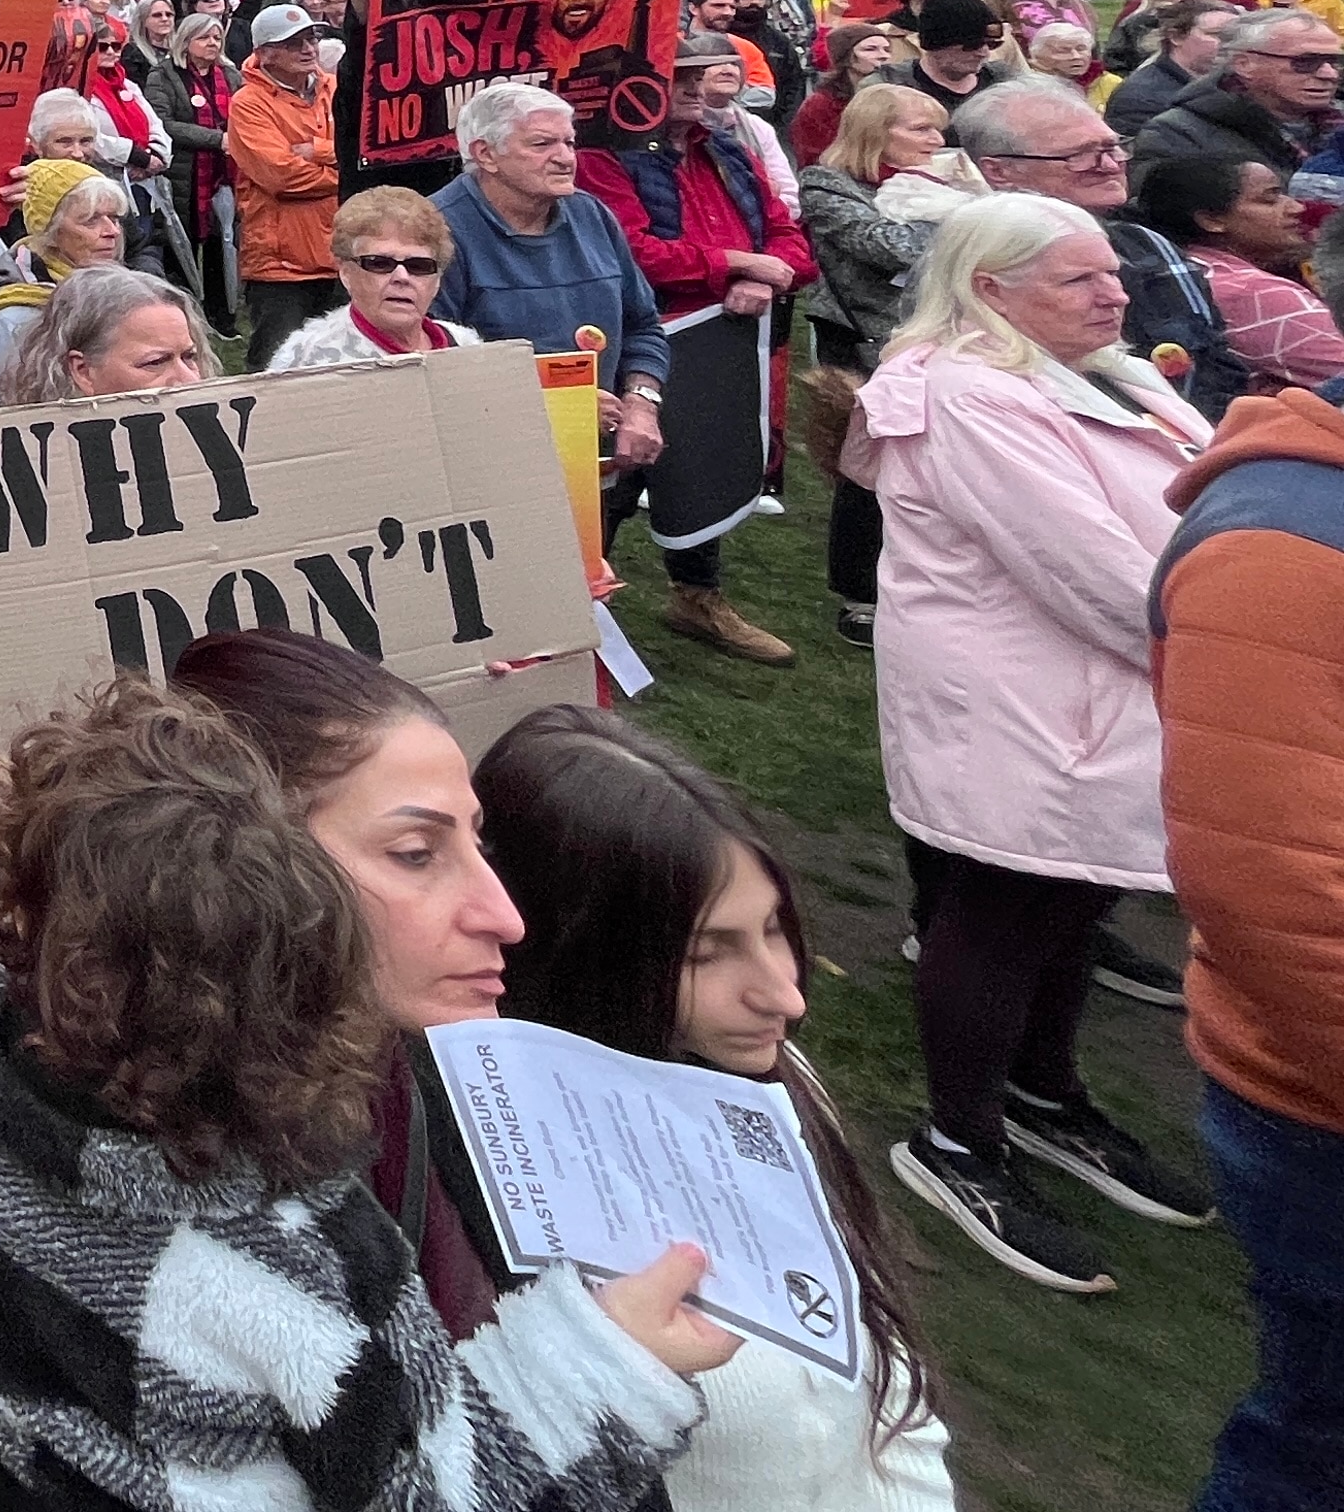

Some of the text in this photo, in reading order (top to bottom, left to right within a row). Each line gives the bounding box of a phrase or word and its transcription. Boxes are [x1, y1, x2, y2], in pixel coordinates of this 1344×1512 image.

[381, 9, 531, 90] JOSH,
[377, 94, 422, 144] NO
[465, 1082, 527, 1212] NO SUNBURY
[476, 1044, 539, 1177] INCINERATOR
[526, 1182, 566, 1254] WASTE
